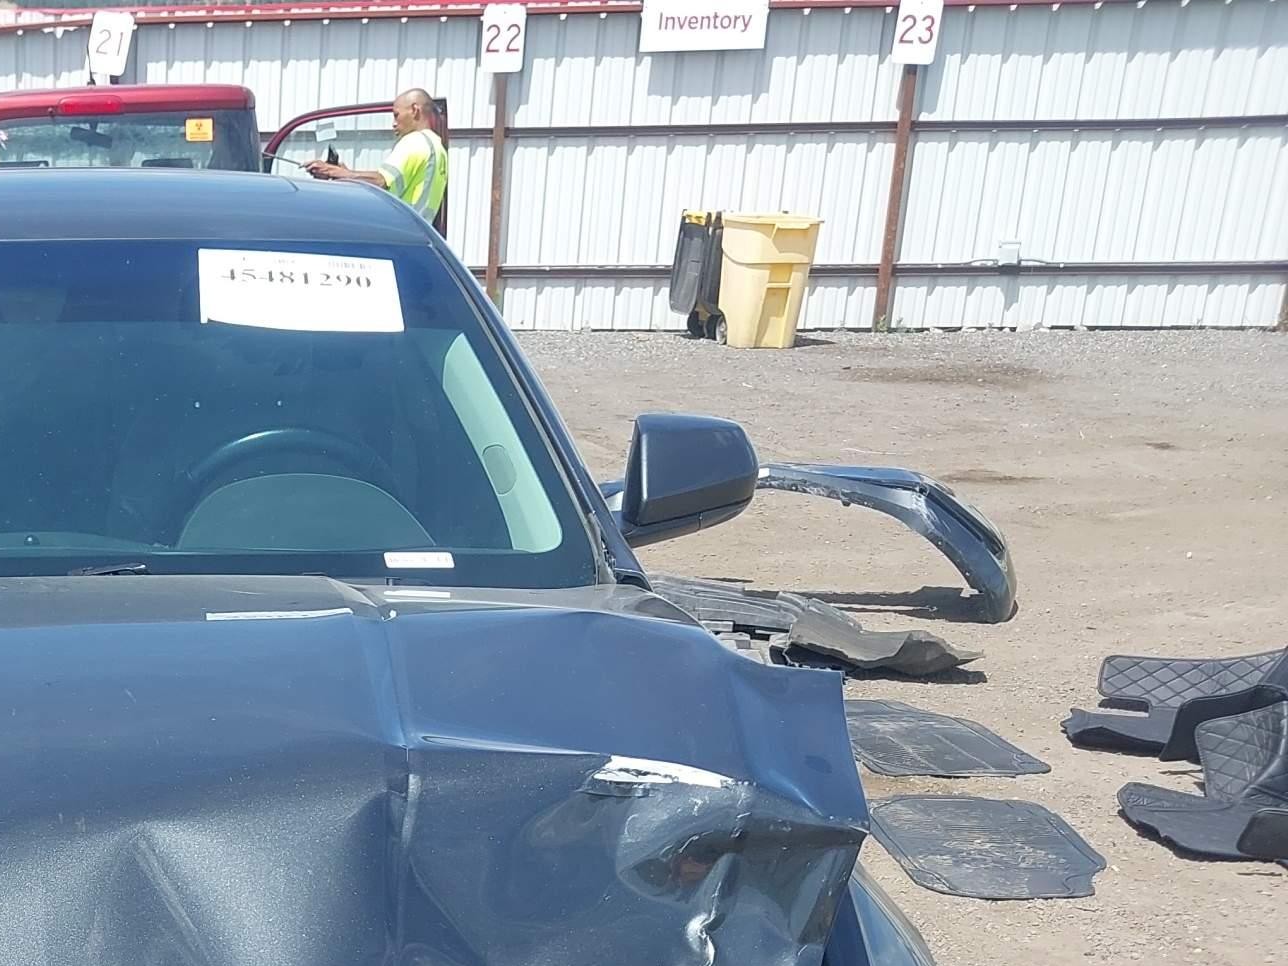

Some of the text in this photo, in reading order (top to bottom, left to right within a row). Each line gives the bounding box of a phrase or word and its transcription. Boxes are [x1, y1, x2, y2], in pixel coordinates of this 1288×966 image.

[658, 11, 752, 31] Inventory
[898, 15, 934, 44] 23
[96, 29, 123, 56] 21
[485, 24, 520, 52] 22
[221, 268, 372, 288] 45481290
